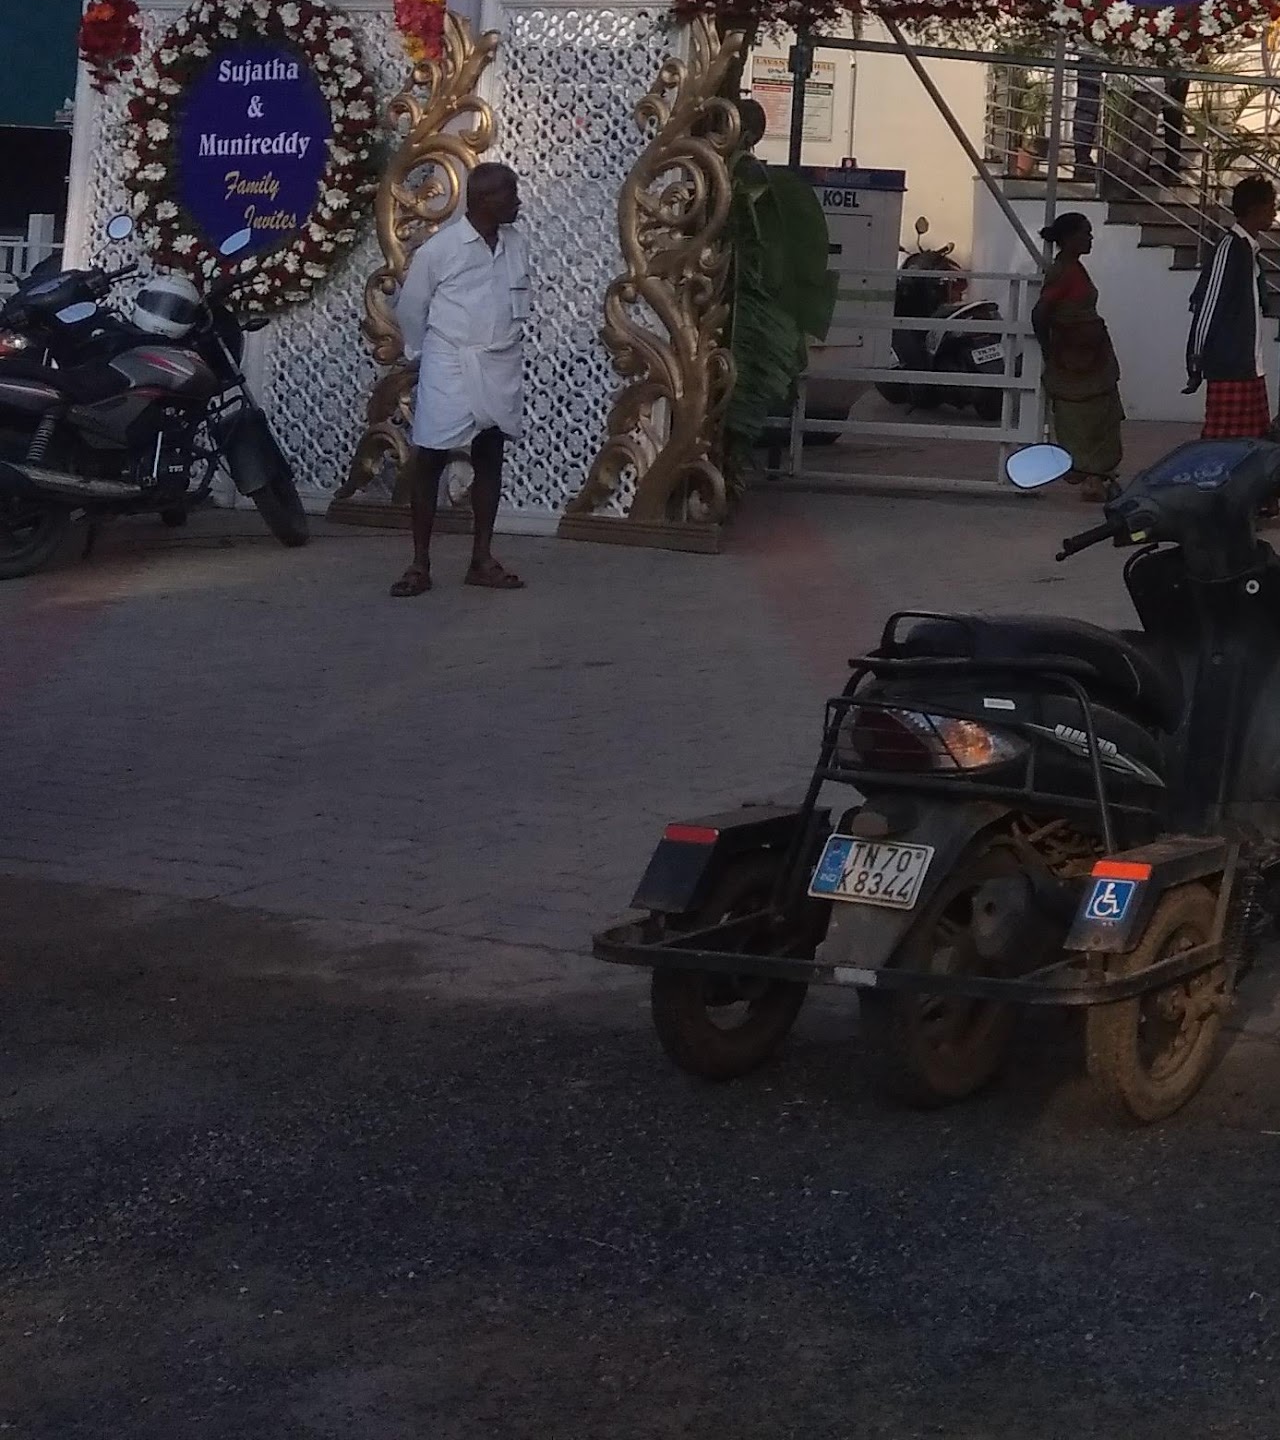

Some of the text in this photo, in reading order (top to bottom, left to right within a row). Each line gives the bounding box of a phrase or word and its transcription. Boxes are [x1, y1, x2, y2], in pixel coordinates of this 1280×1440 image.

[217, 58, 300, 87] Sujatha
[246, 95, 265, 119] &
[198, 131, 312, 160] Munireddy
[224, 170, 280, 201] Family
[822, 189, 860, 208] KOEL
[243, 204, 298, 230] Invites
